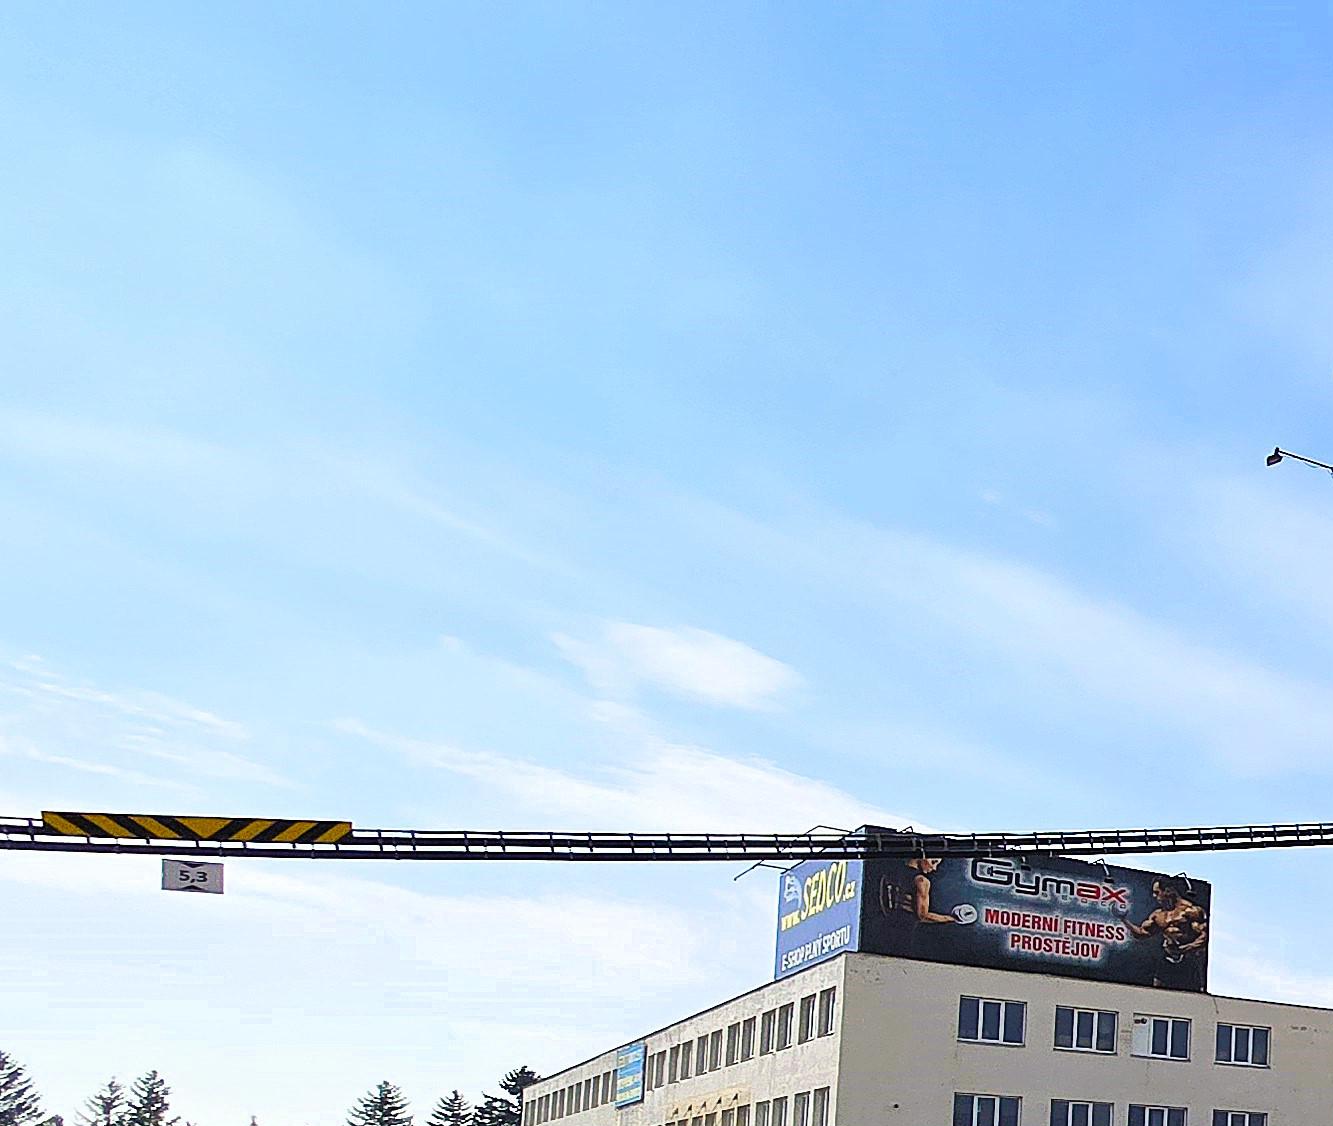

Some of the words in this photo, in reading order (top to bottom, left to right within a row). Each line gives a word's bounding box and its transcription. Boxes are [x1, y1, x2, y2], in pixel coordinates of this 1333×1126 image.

[179, 870, 207, 883] 5,3
[985, 908, 1058, 932] MODERNÍ
[1063, 919, 1125, 941] FITNESS
[1010, 933, 1100, 958] PROSTĚJOV
